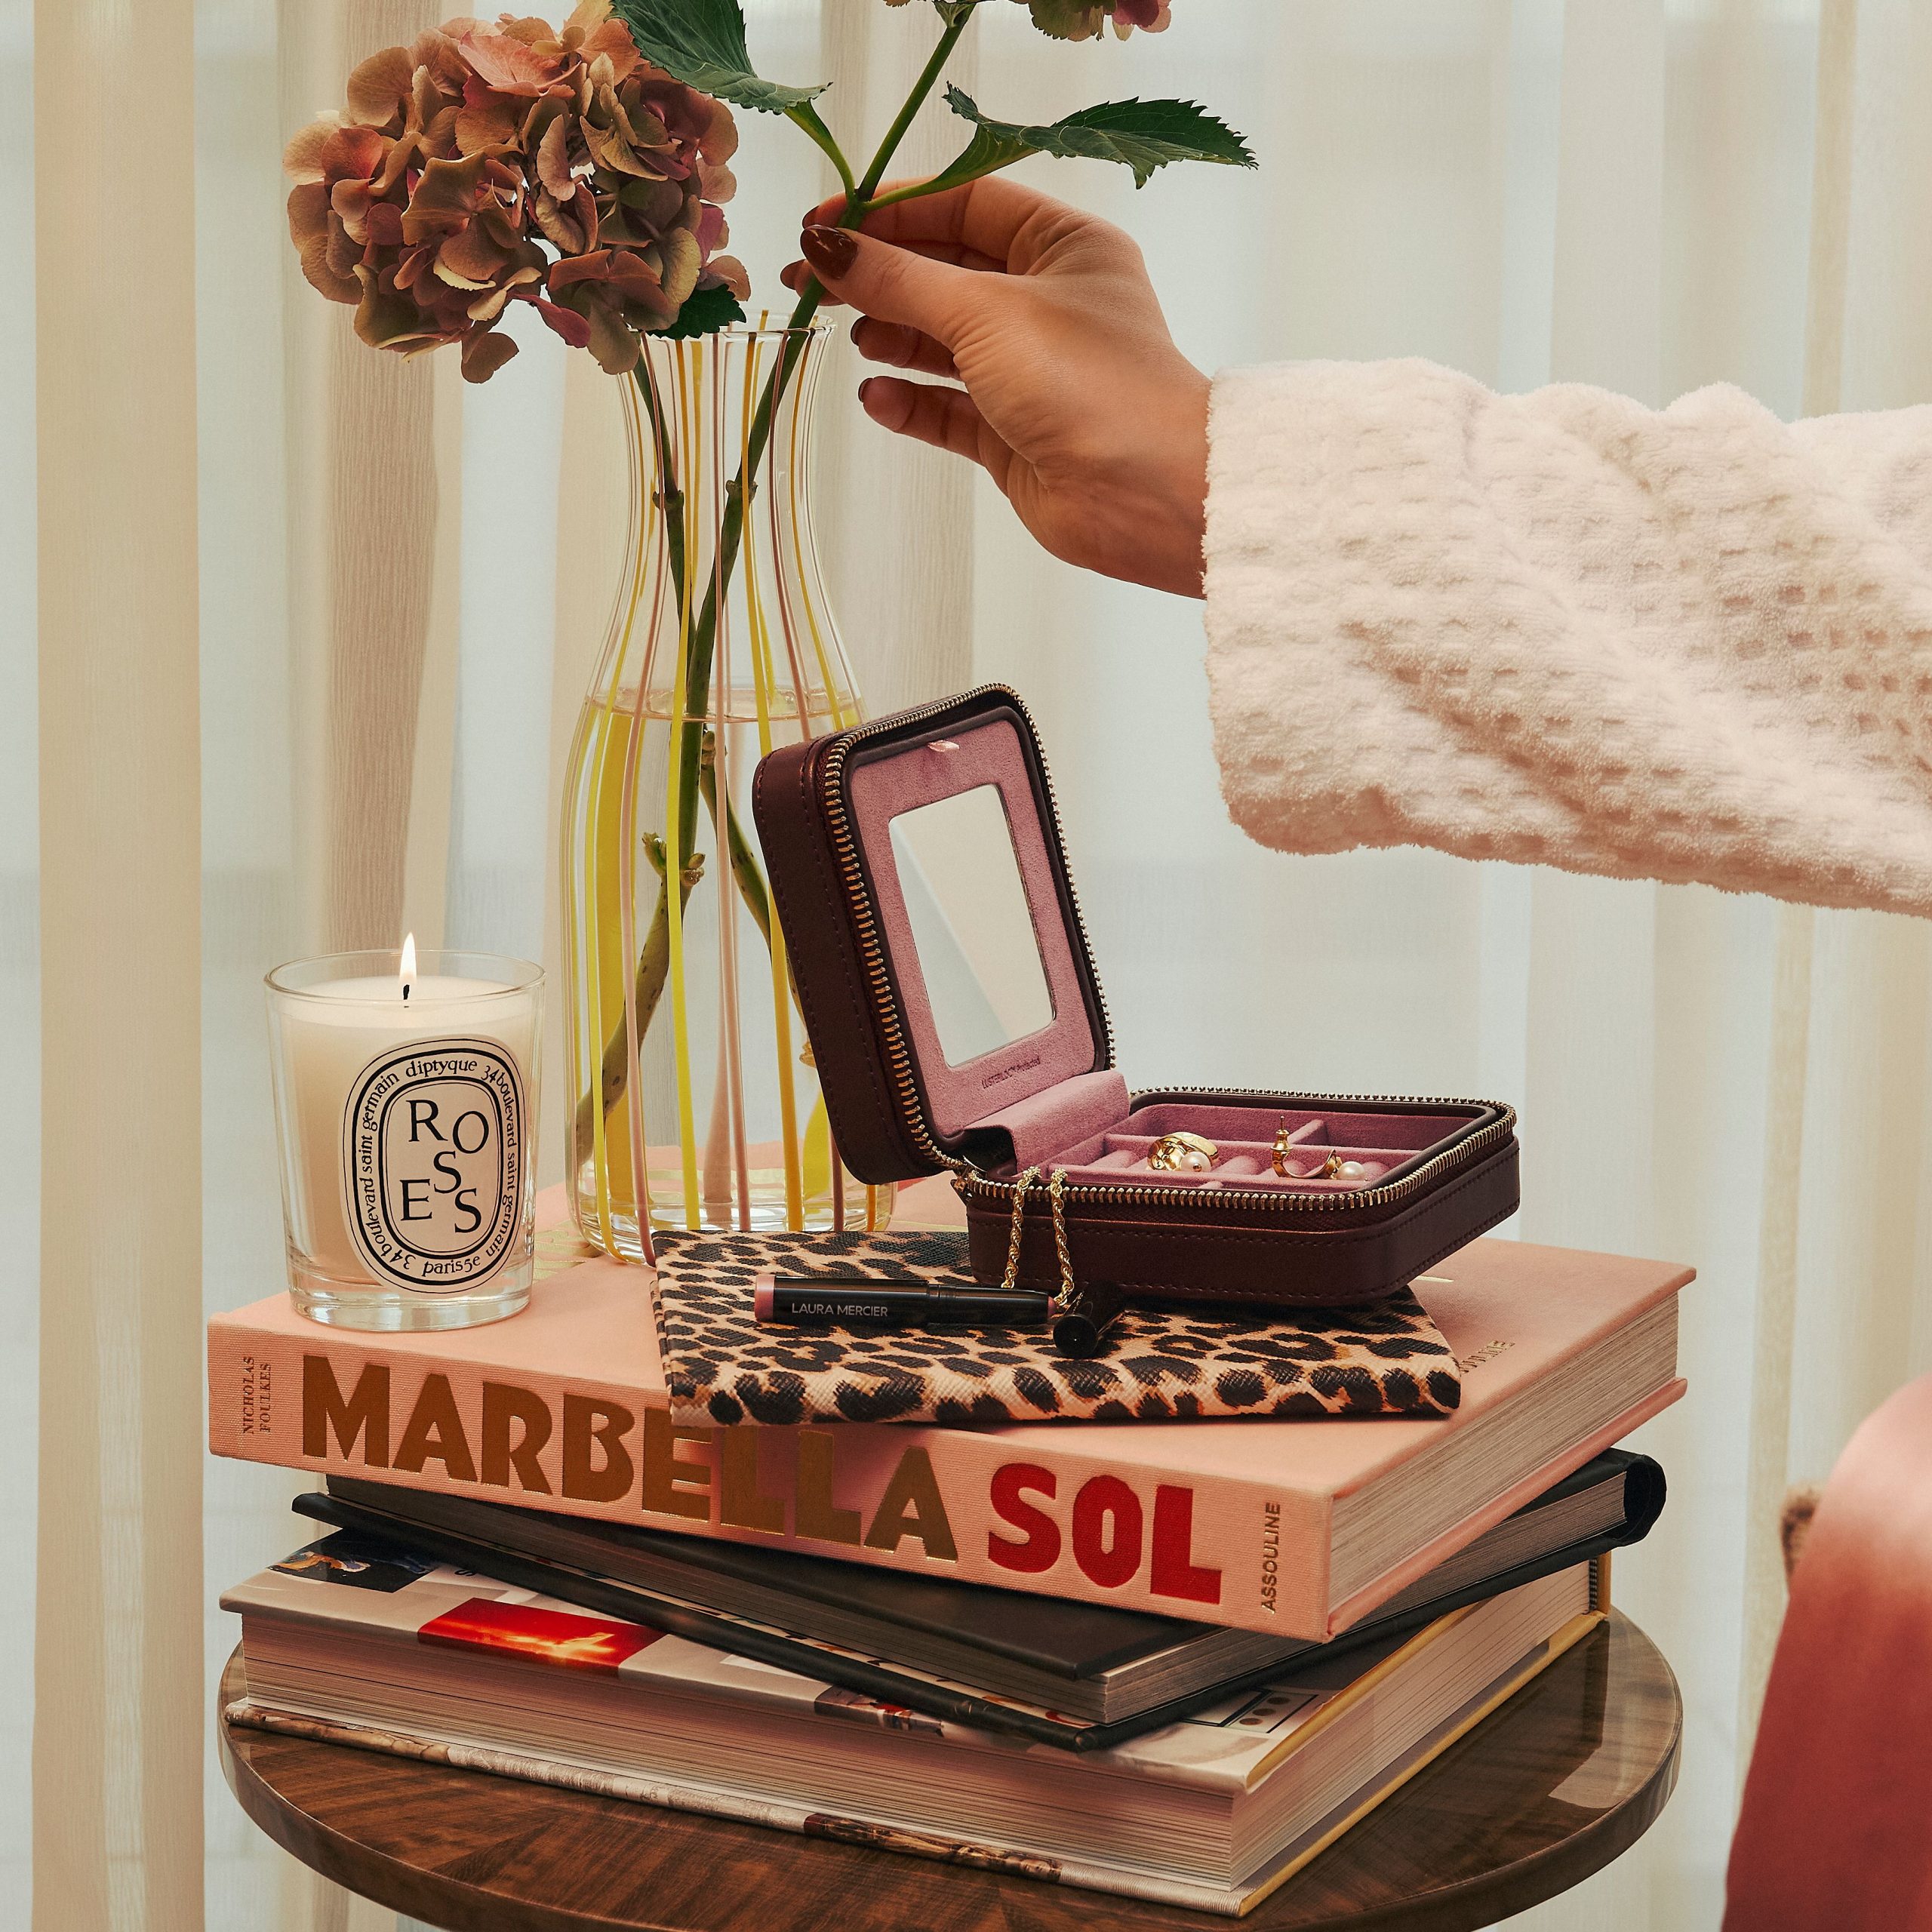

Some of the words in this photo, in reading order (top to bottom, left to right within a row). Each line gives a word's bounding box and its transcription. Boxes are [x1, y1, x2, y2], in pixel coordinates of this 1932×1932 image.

[405, 1060, 478, 1078] diptyque
[362, 1072, 400, 1131] germain
[358, 1135, 373, 1174] saint
[507, 1152, 517, 1191] saint
[485, 1194, 513, 1257] germain
[792, 1303, 834, 1315] LAURA
[837, 1304, 888, 1317] MERCIER
[243, 1356, 254, 1435] NICHOLAS
[260, 1364, 271, 1433] FOULKES
[302, 1355, 958, 1563] MARBELLA
[987, 1462, 1222, 1604] SOL
[1261, 1502, 1281, 1614] ASSOULINE
